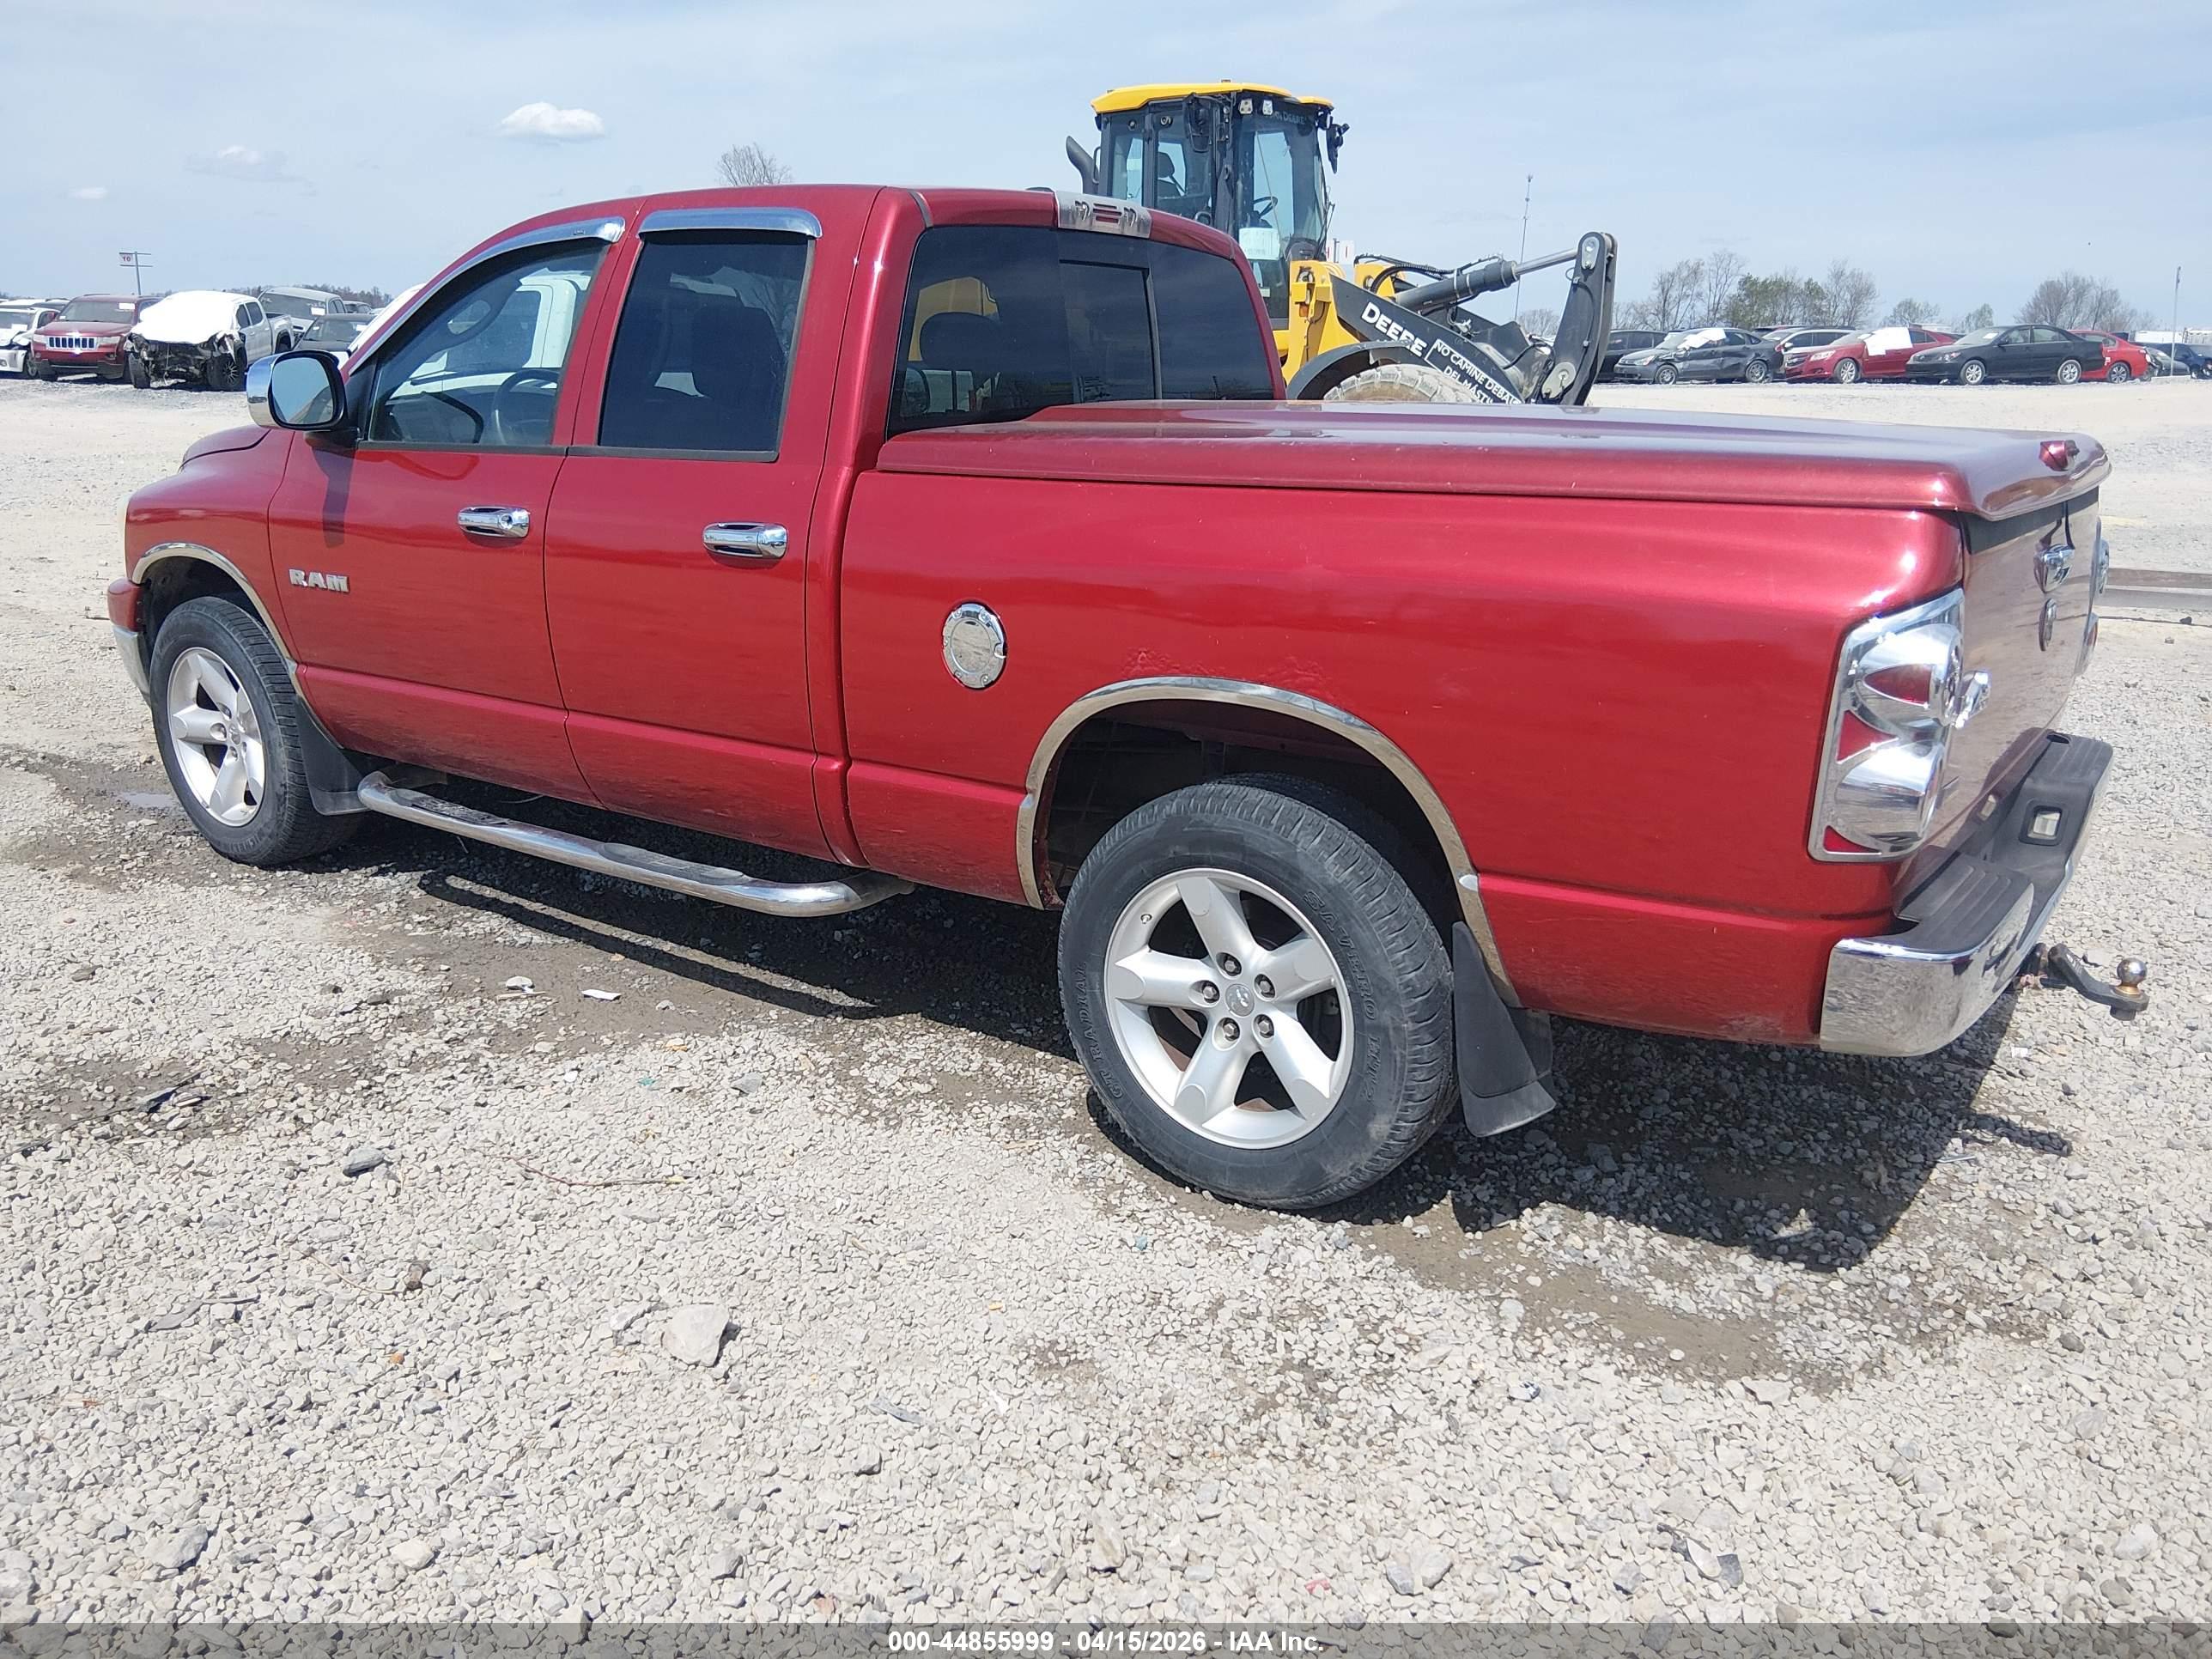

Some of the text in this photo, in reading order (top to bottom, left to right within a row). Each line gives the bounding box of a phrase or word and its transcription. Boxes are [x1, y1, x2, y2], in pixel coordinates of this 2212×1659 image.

[1361, 301, 1427, 357] DEERE
[1435, 342, 1450, 356] NO
[1450, 354, 1486, 385] CAMINE
[1443, 365, 1462, 382] DEL
[289, 568, 349, 592] RAM
[1303, 890, 1376, 1020] SAVERO
[1075, 962, 1103, 1062] RADIAL
